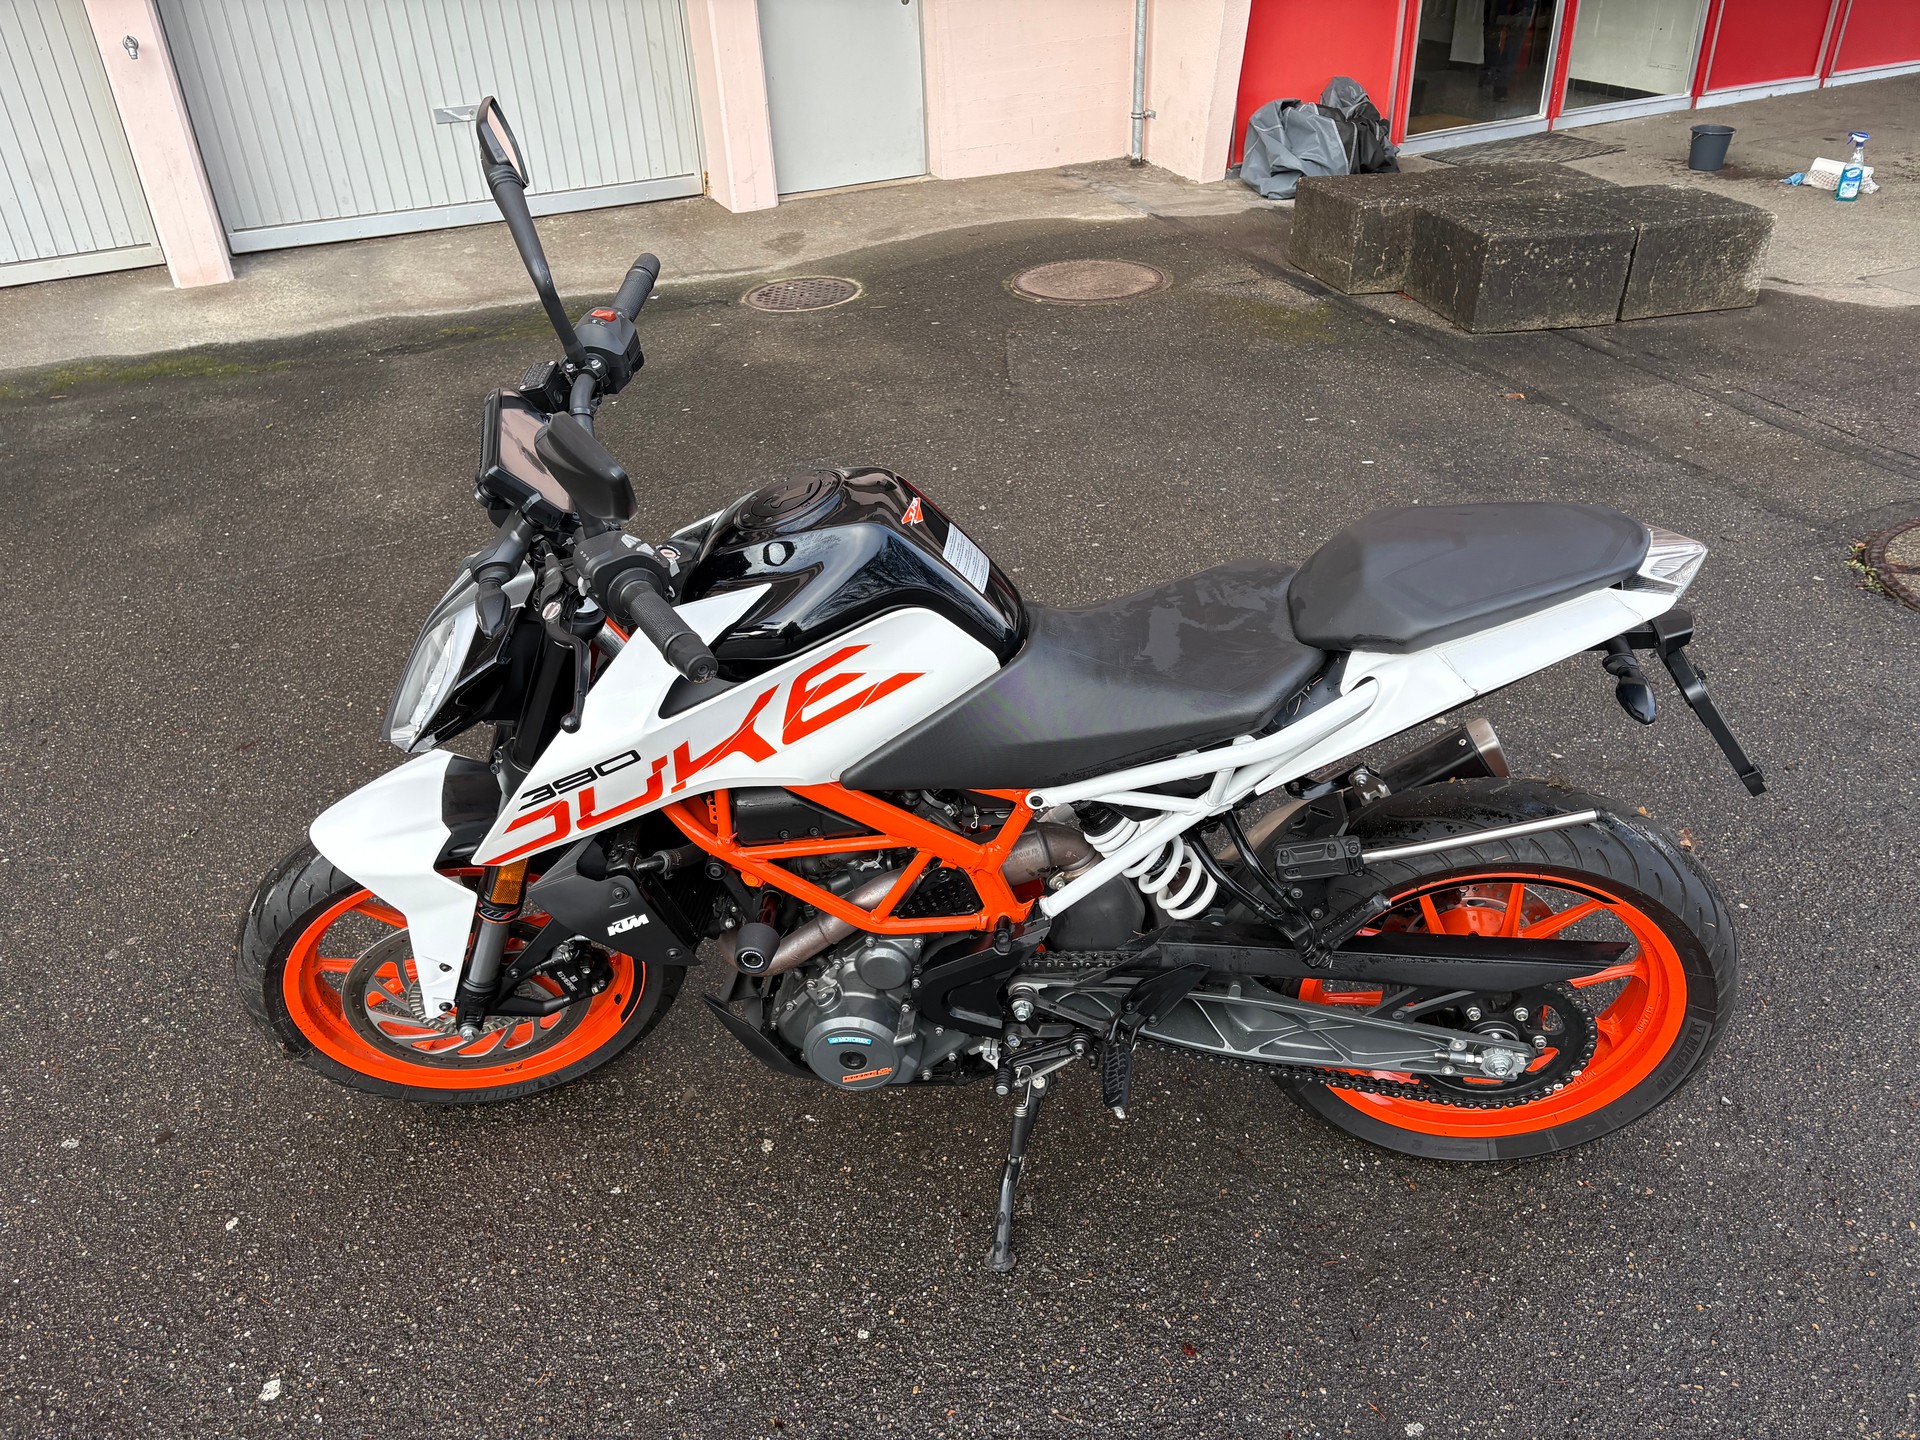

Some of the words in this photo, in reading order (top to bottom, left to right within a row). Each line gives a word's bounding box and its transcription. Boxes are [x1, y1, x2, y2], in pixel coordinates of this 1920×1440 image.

[482, 644, 926, 865] DUKE
[518, 749, 642, 811] 390
[607, 914, 649, 937] KTM
[456, 1081, 539, 1101] MICHELIN
